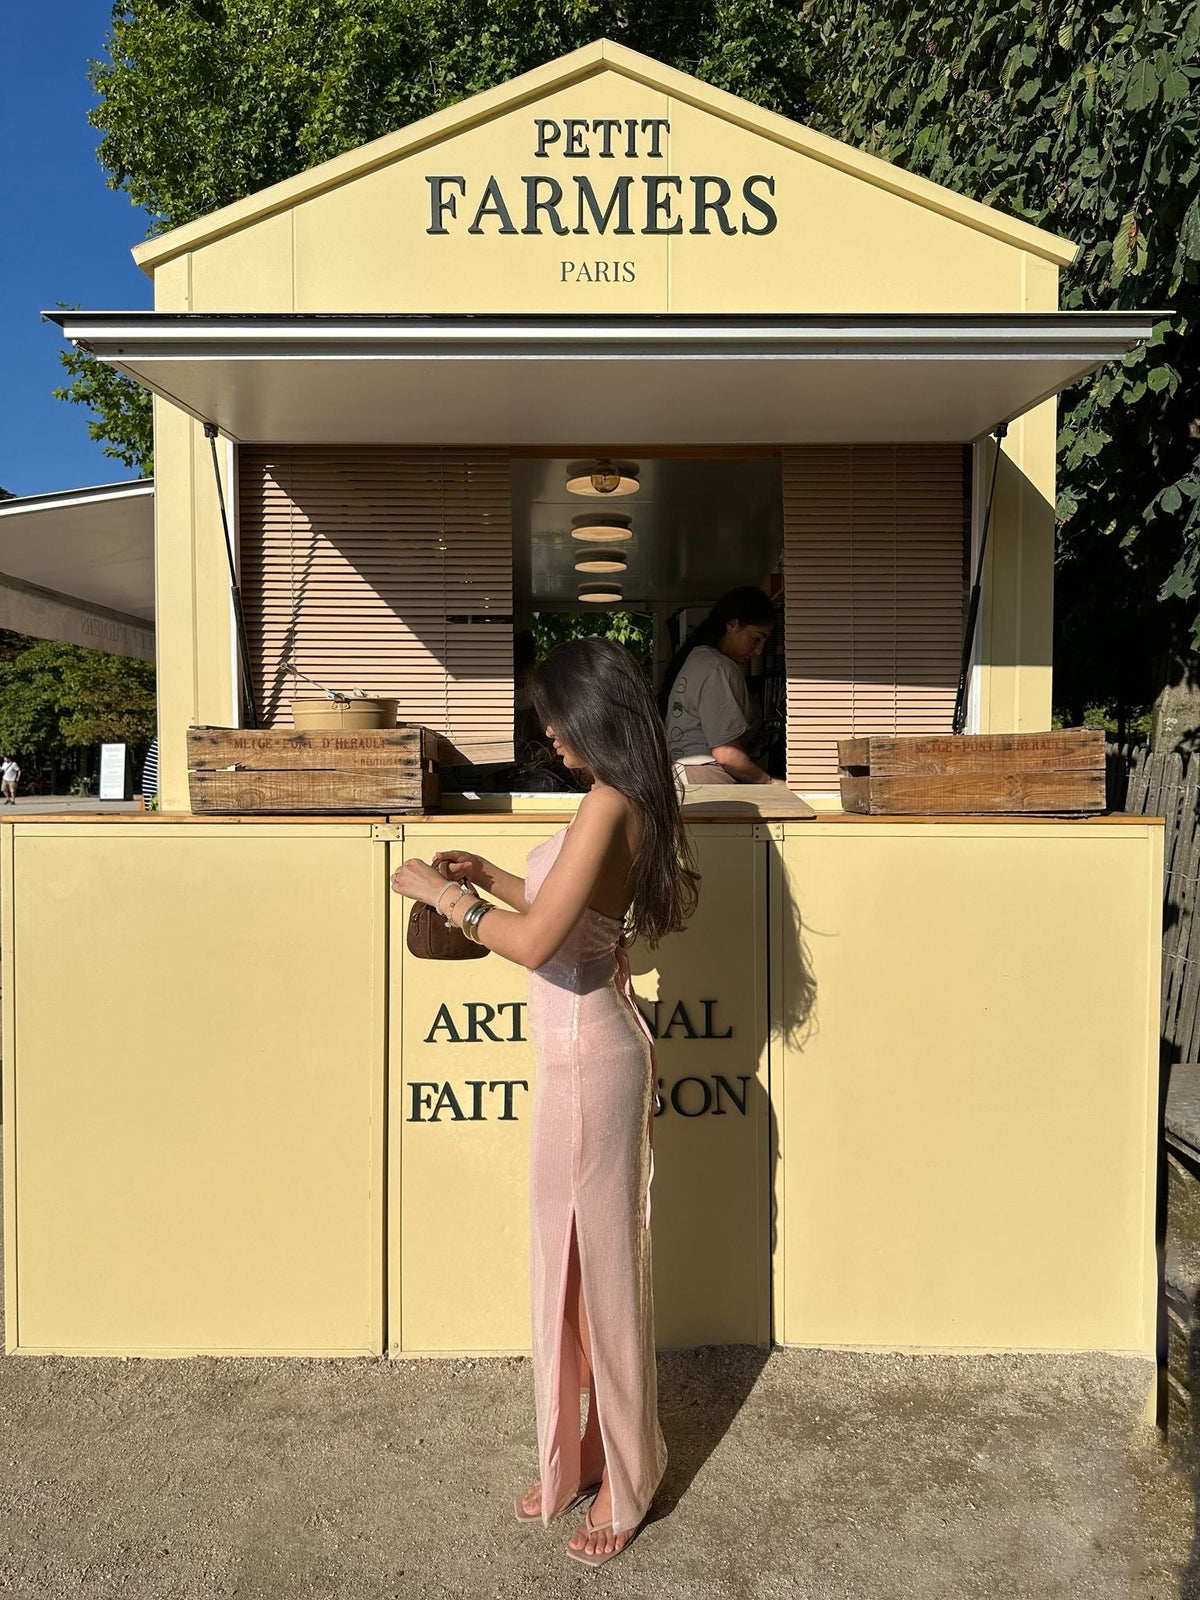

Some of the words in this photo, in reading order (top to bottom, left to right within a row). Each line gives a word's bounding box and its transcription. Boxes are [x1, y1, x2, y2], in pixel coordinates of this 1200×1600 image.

[534, 119, 670, 158] PETIT
[425, 175, 778, 236] FARMERS
[560, 261, 636, 282] PARIS
[406, 1080, 529, 1122] FAIT
